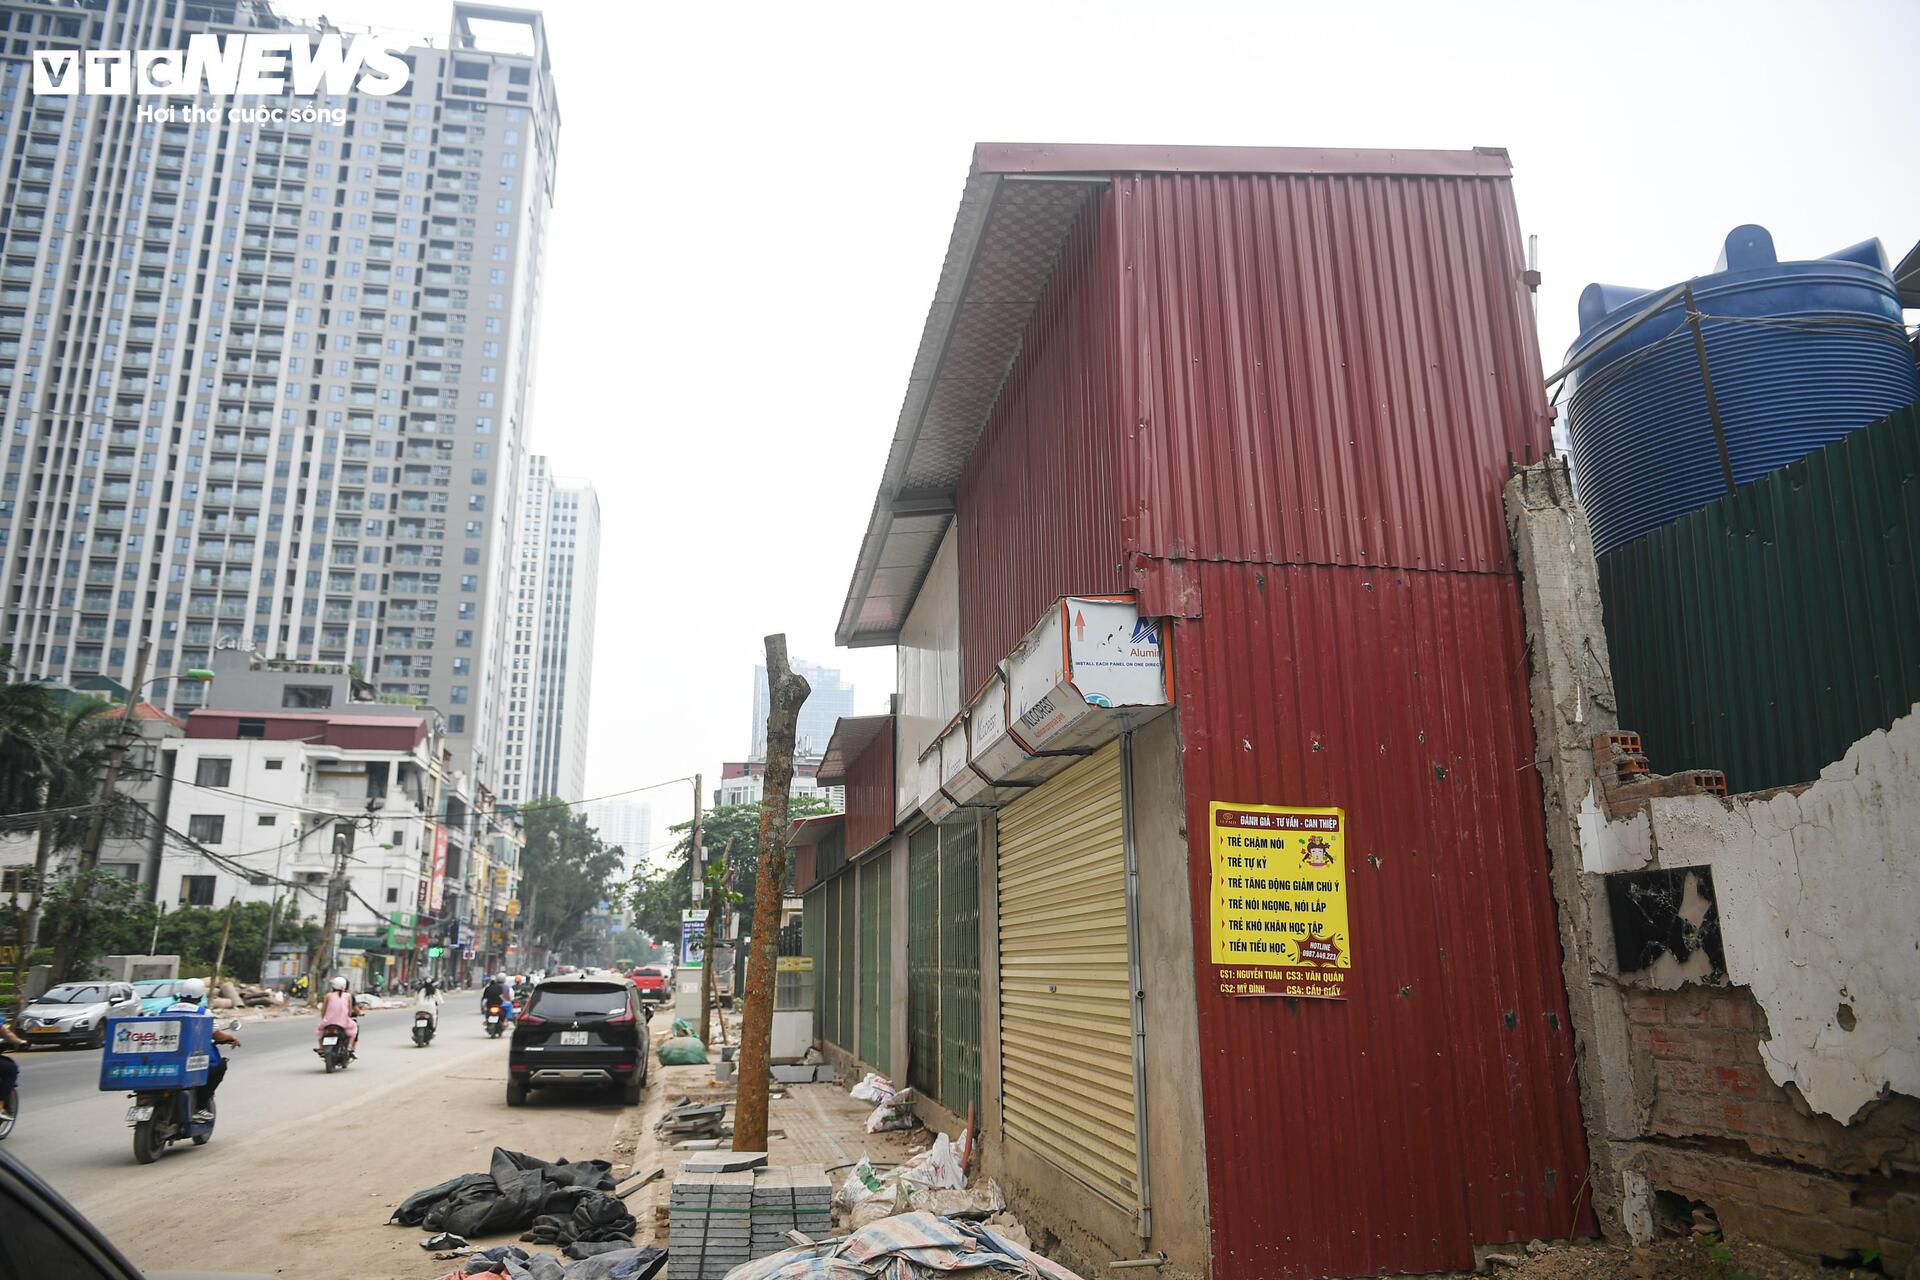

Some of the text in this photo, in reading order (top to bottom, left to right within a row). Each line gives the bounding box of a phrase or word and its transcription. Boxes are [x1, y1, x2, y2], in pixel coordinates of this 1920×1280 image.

[1240, 814, 1259, 826] ĐÁNH
[1260, 815, 1271, 827] GIÁ
[1276, 817, 1286, 827] TƯ
[1286, 815, 1299, 828] VẤN
[1304, 818, 1318, 828] CAN
[1320, 818, 1338, 831] THIỆP
[1227, 834, 1284, 850] TRẺ CHẬM NÓI
[1228, 854, 1267, 870] TRẺ TỰ KỶ
[1228, 875, 1340, 893] TRẺ TĂNG ĐỘNG GIẢM CHÚ Ý
[1229, 896, 1327, 913] TRẺ NÓI NGỌNG, NÓI LẮP
[1229, 917, 1323, 935] TRẺ KHÓ KHĂN HỌC TẬP
[1250, 938, 1267, 953] TIỂU
[1269, 943, 1286, 956] HỌC
[1309, 941, 1331, 951] HOTLINE
[1220, 968, 1283, 980] CS1: NGUYỄN TUÂN
[1286, 971, 1344, 983] CS3: VĂN QUÁN
[1220, 983, 1265, 993] CS2: MỸ ĐÌNH
[1286, 985, 1304, 995] CS4:
[1323, 984, 1341, 996] GIẤY
